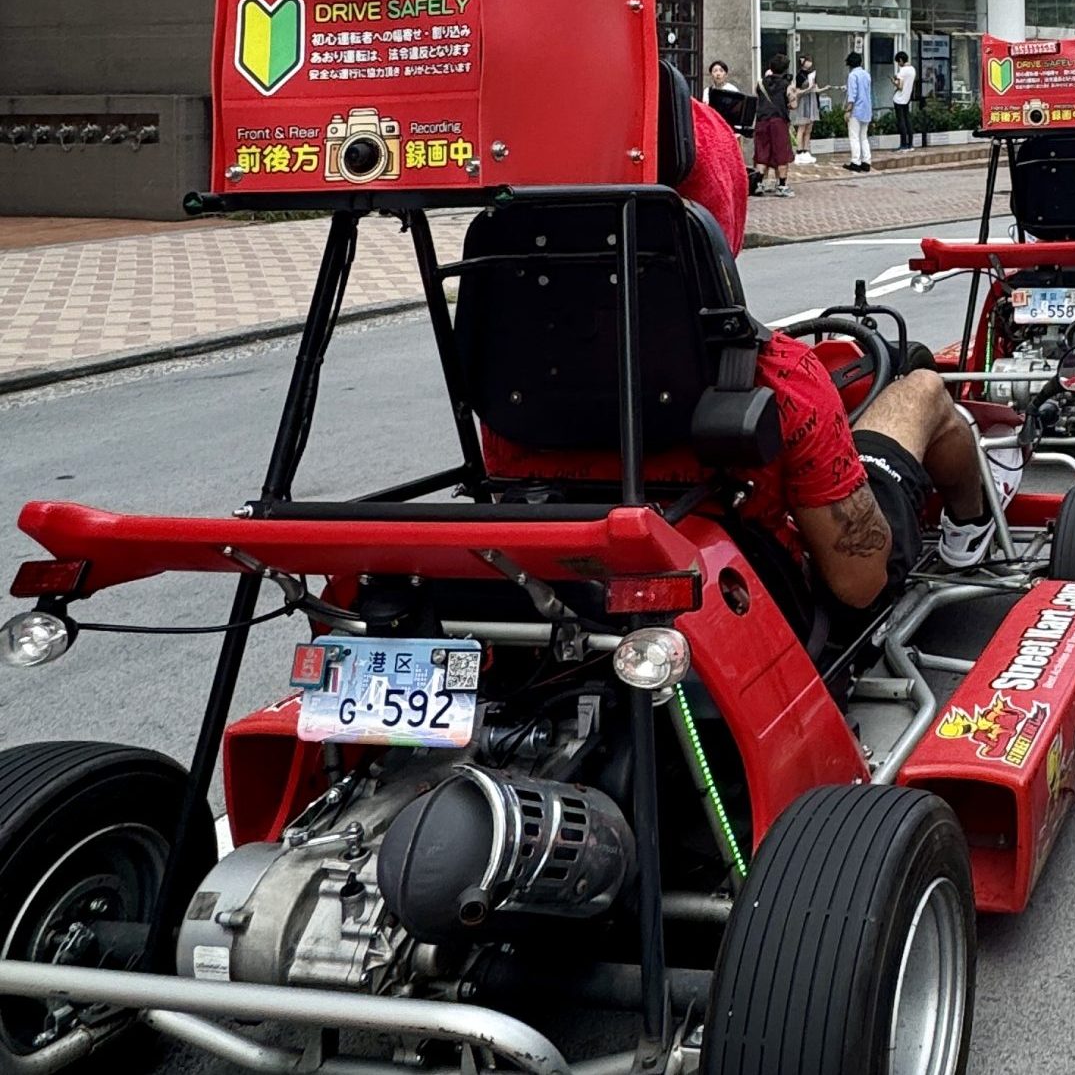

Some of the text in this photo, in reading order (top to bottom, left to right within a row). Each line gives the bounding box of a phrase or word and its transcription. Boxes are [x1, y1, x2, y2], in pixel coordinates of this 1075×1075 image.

[314, 1, 382, 24] DRIVE
[237, 126, 320, 141] Front & Rear
[410, 121, 462, 135] Recording
[236, 143, 320, 173] 前後方
[405, 137, 473, 169] 録画中
